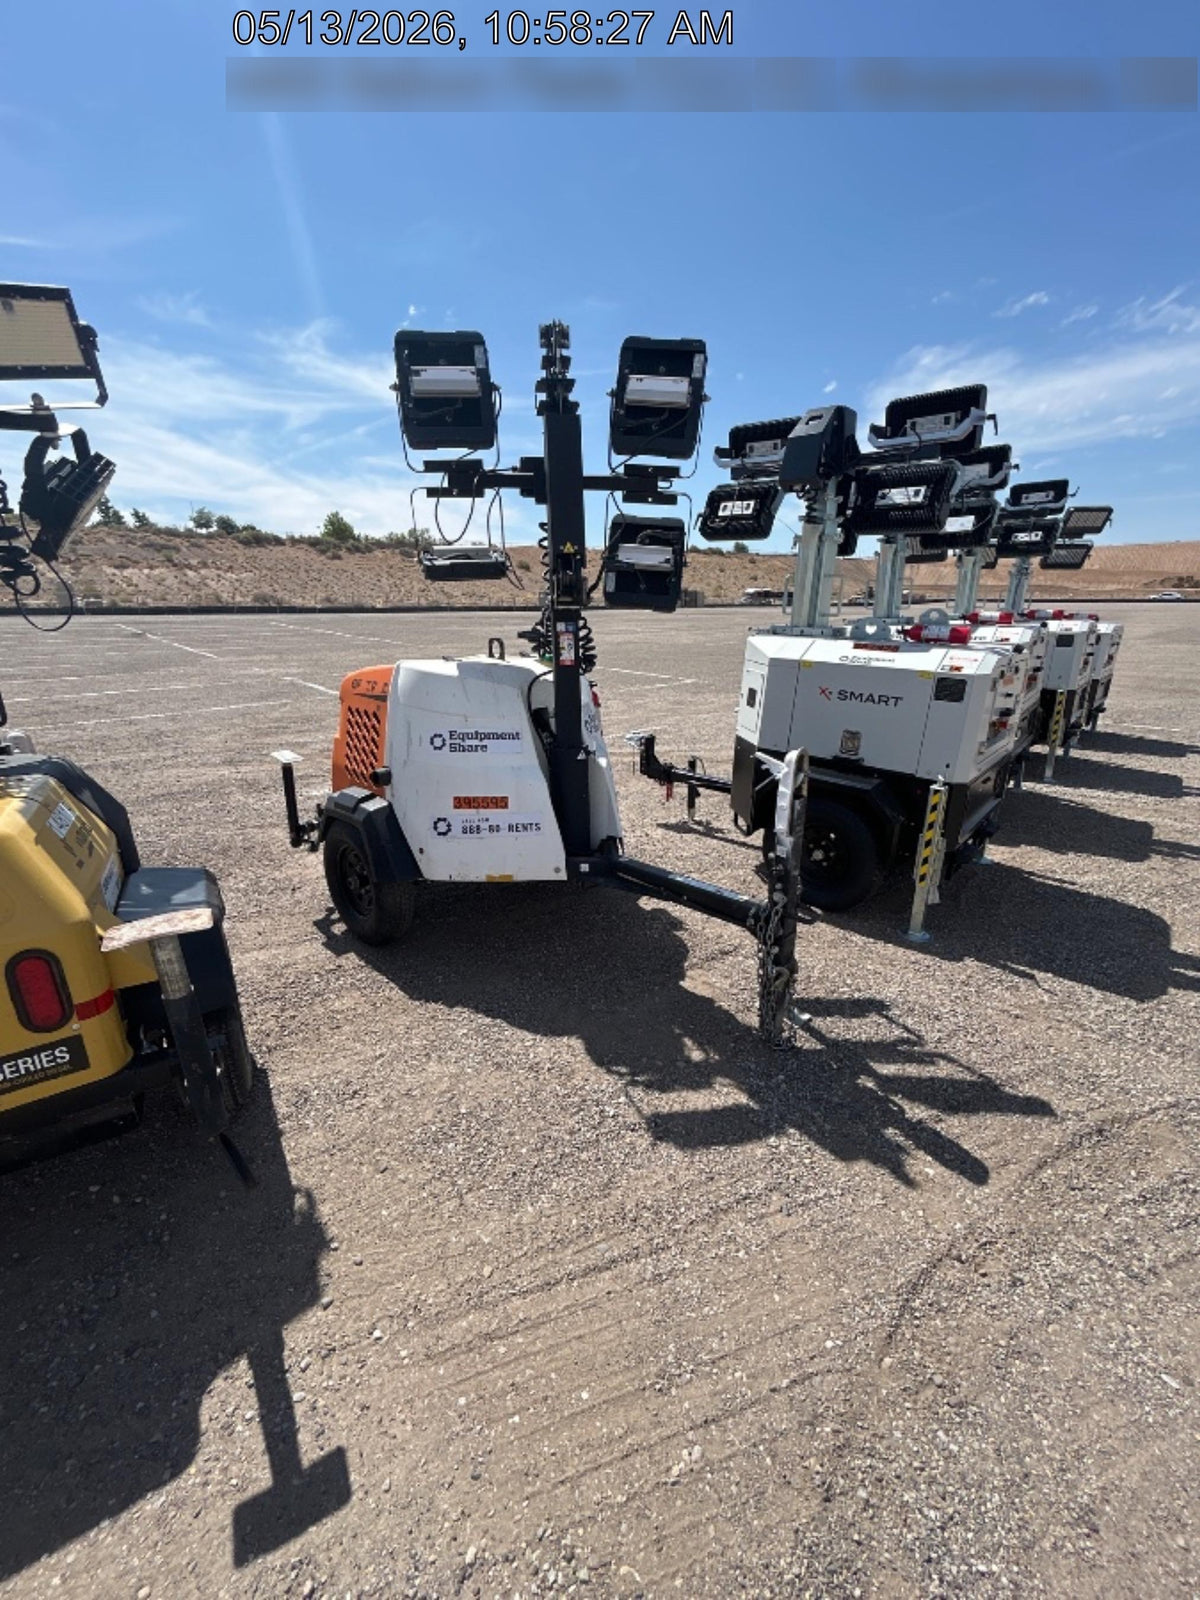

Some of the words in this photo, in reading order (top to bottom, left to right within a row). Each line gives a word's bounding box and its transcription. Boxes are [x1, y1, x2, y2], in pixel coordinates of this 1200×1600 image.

[837, 689, 903, 708] SMART
[448, 730, 521, 743] Equipment
[449, 743, 488, 753] Share
[0, 1046, 70, 1081] ERIES
